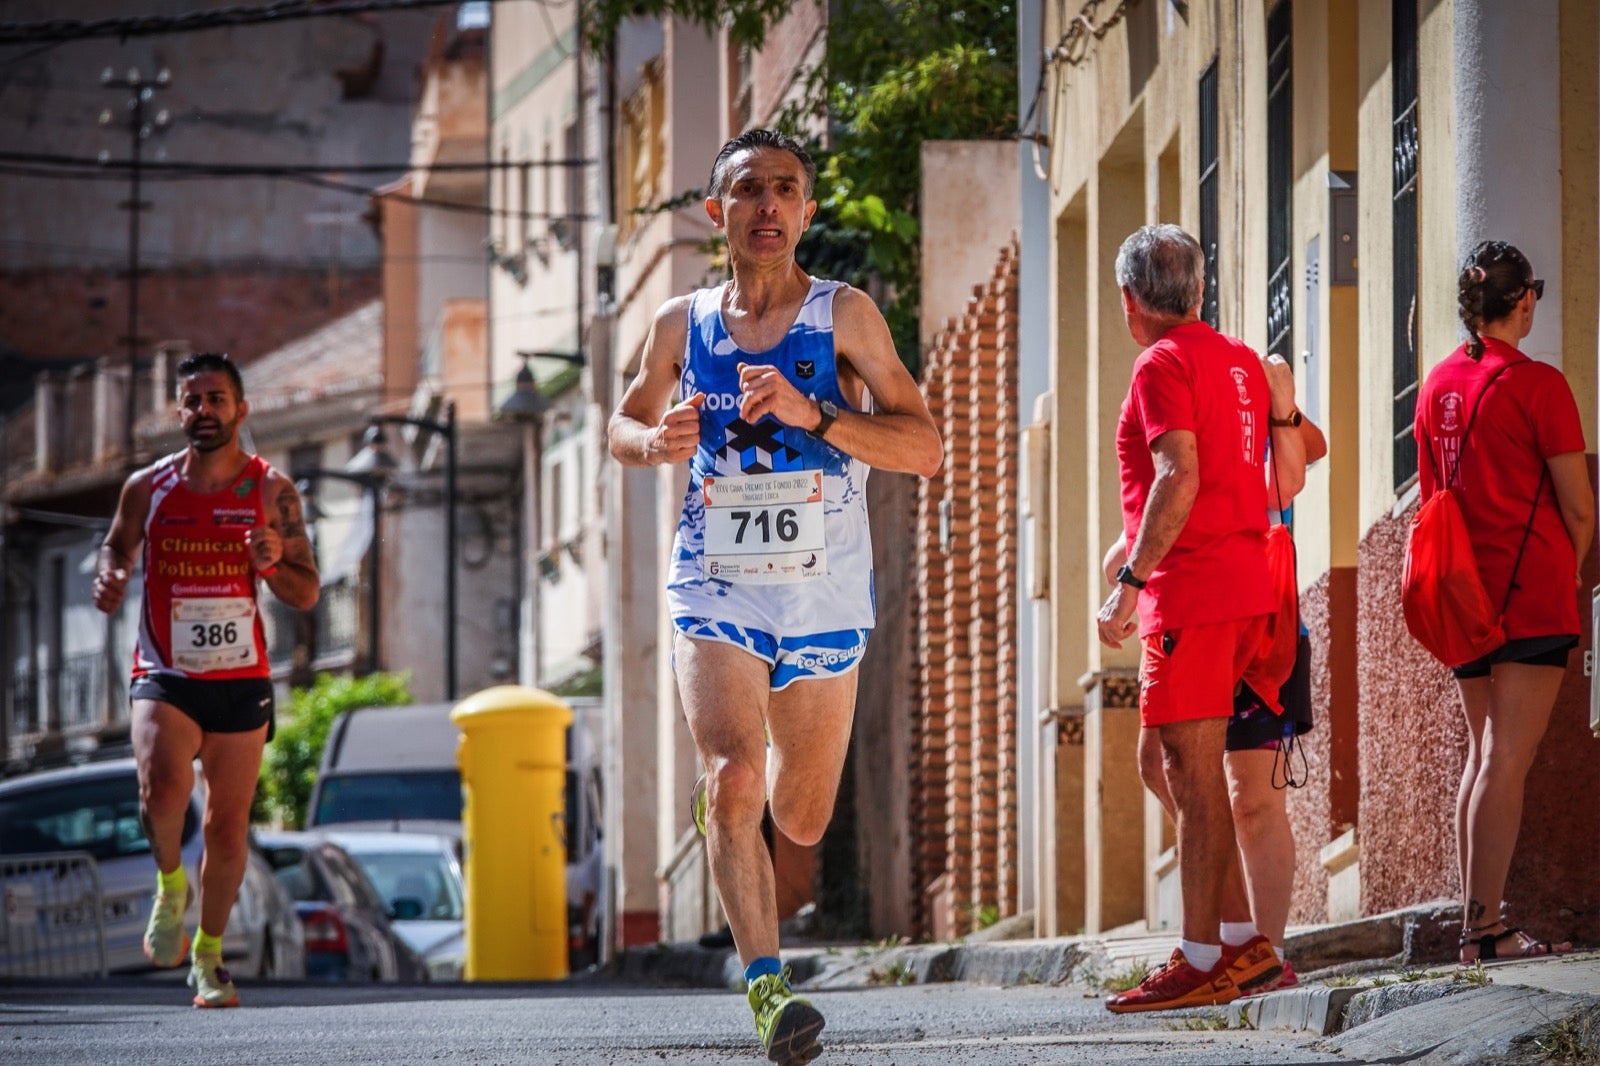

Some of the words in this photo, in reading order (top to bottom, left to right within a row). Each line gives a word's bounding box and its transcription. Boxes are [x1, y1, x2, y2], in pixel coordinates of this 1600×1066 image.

[793, 479, 808, 488] 2022
[731, 508, 799, 544] 716
[159, 560, 249, 577] Polisalud
[171, 583, 232, 595] Continental
[191, 621, 237, 647] 386
